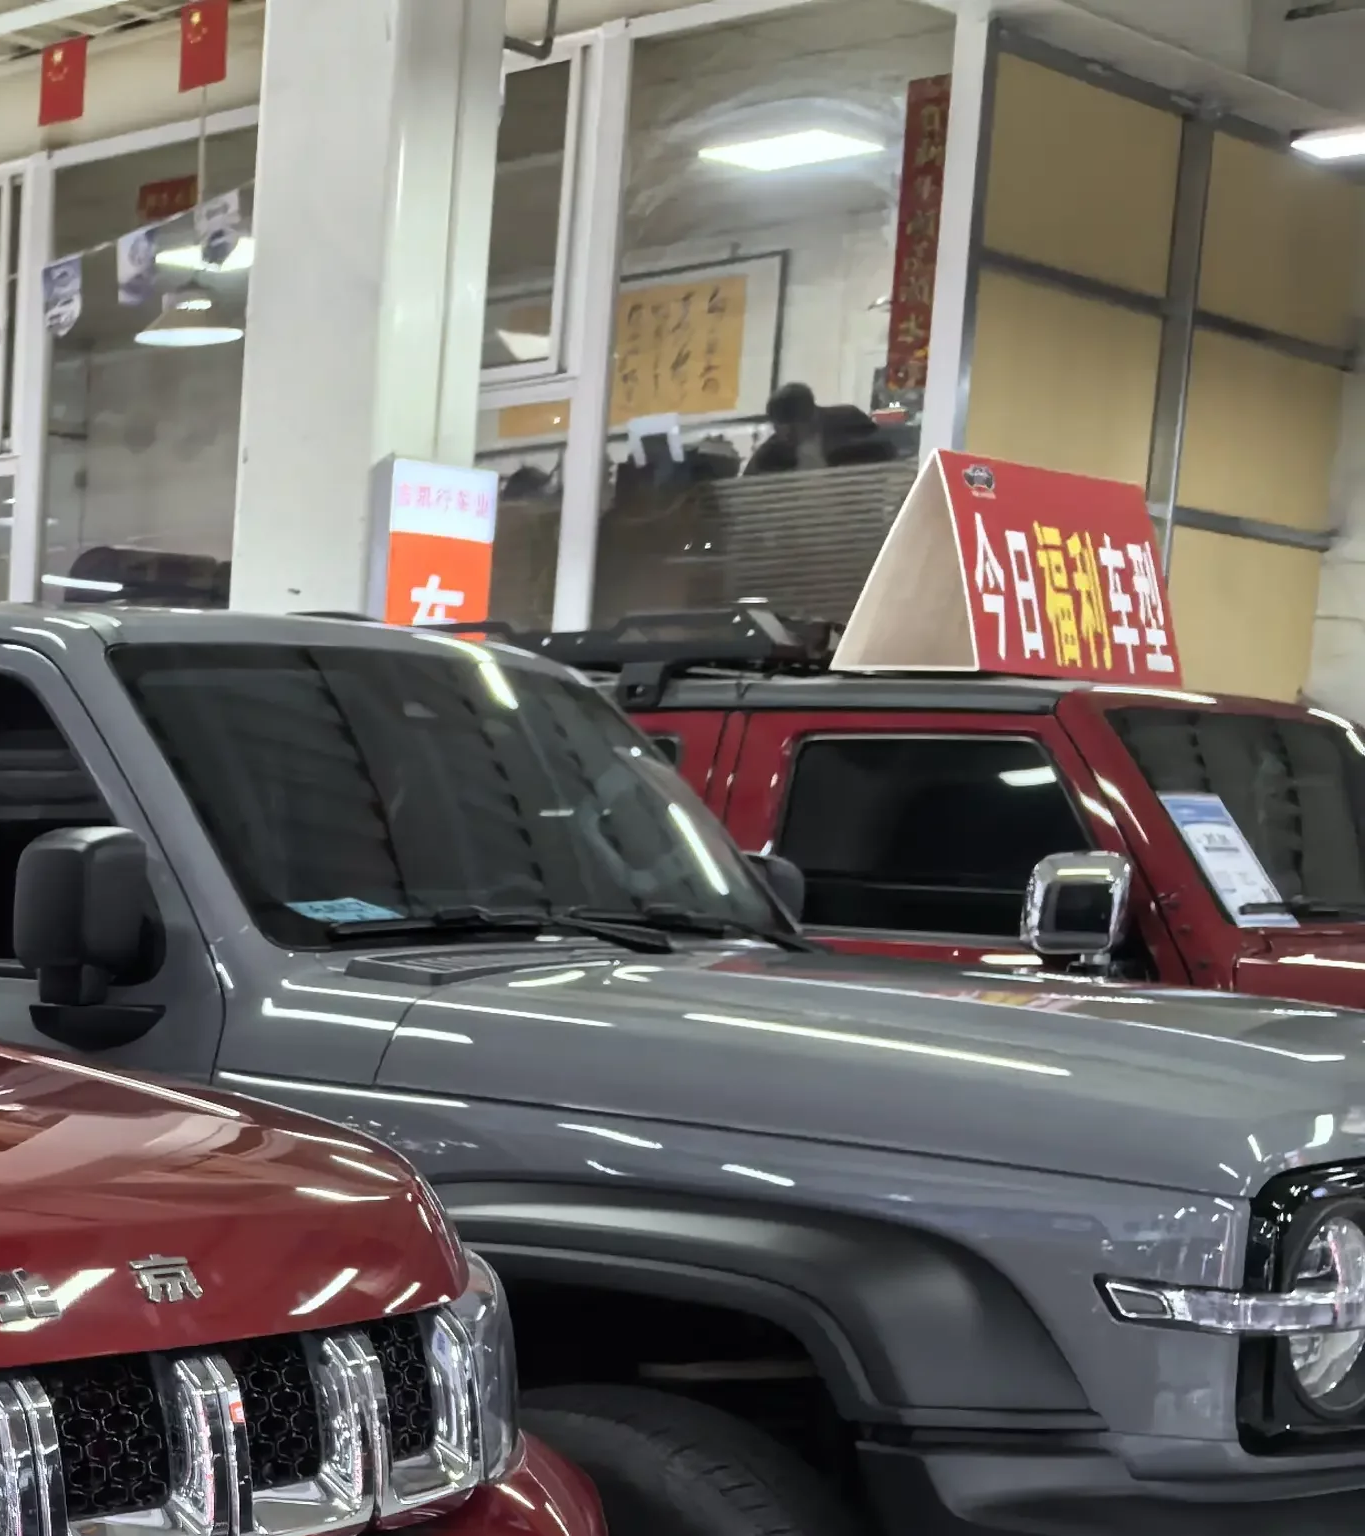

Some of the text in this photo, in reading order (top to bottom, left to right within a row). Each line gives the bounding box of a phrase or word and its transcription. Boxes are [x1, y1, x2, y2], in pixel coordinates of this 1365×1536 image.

[974, 511, 1175, 674] 今日福利车型
